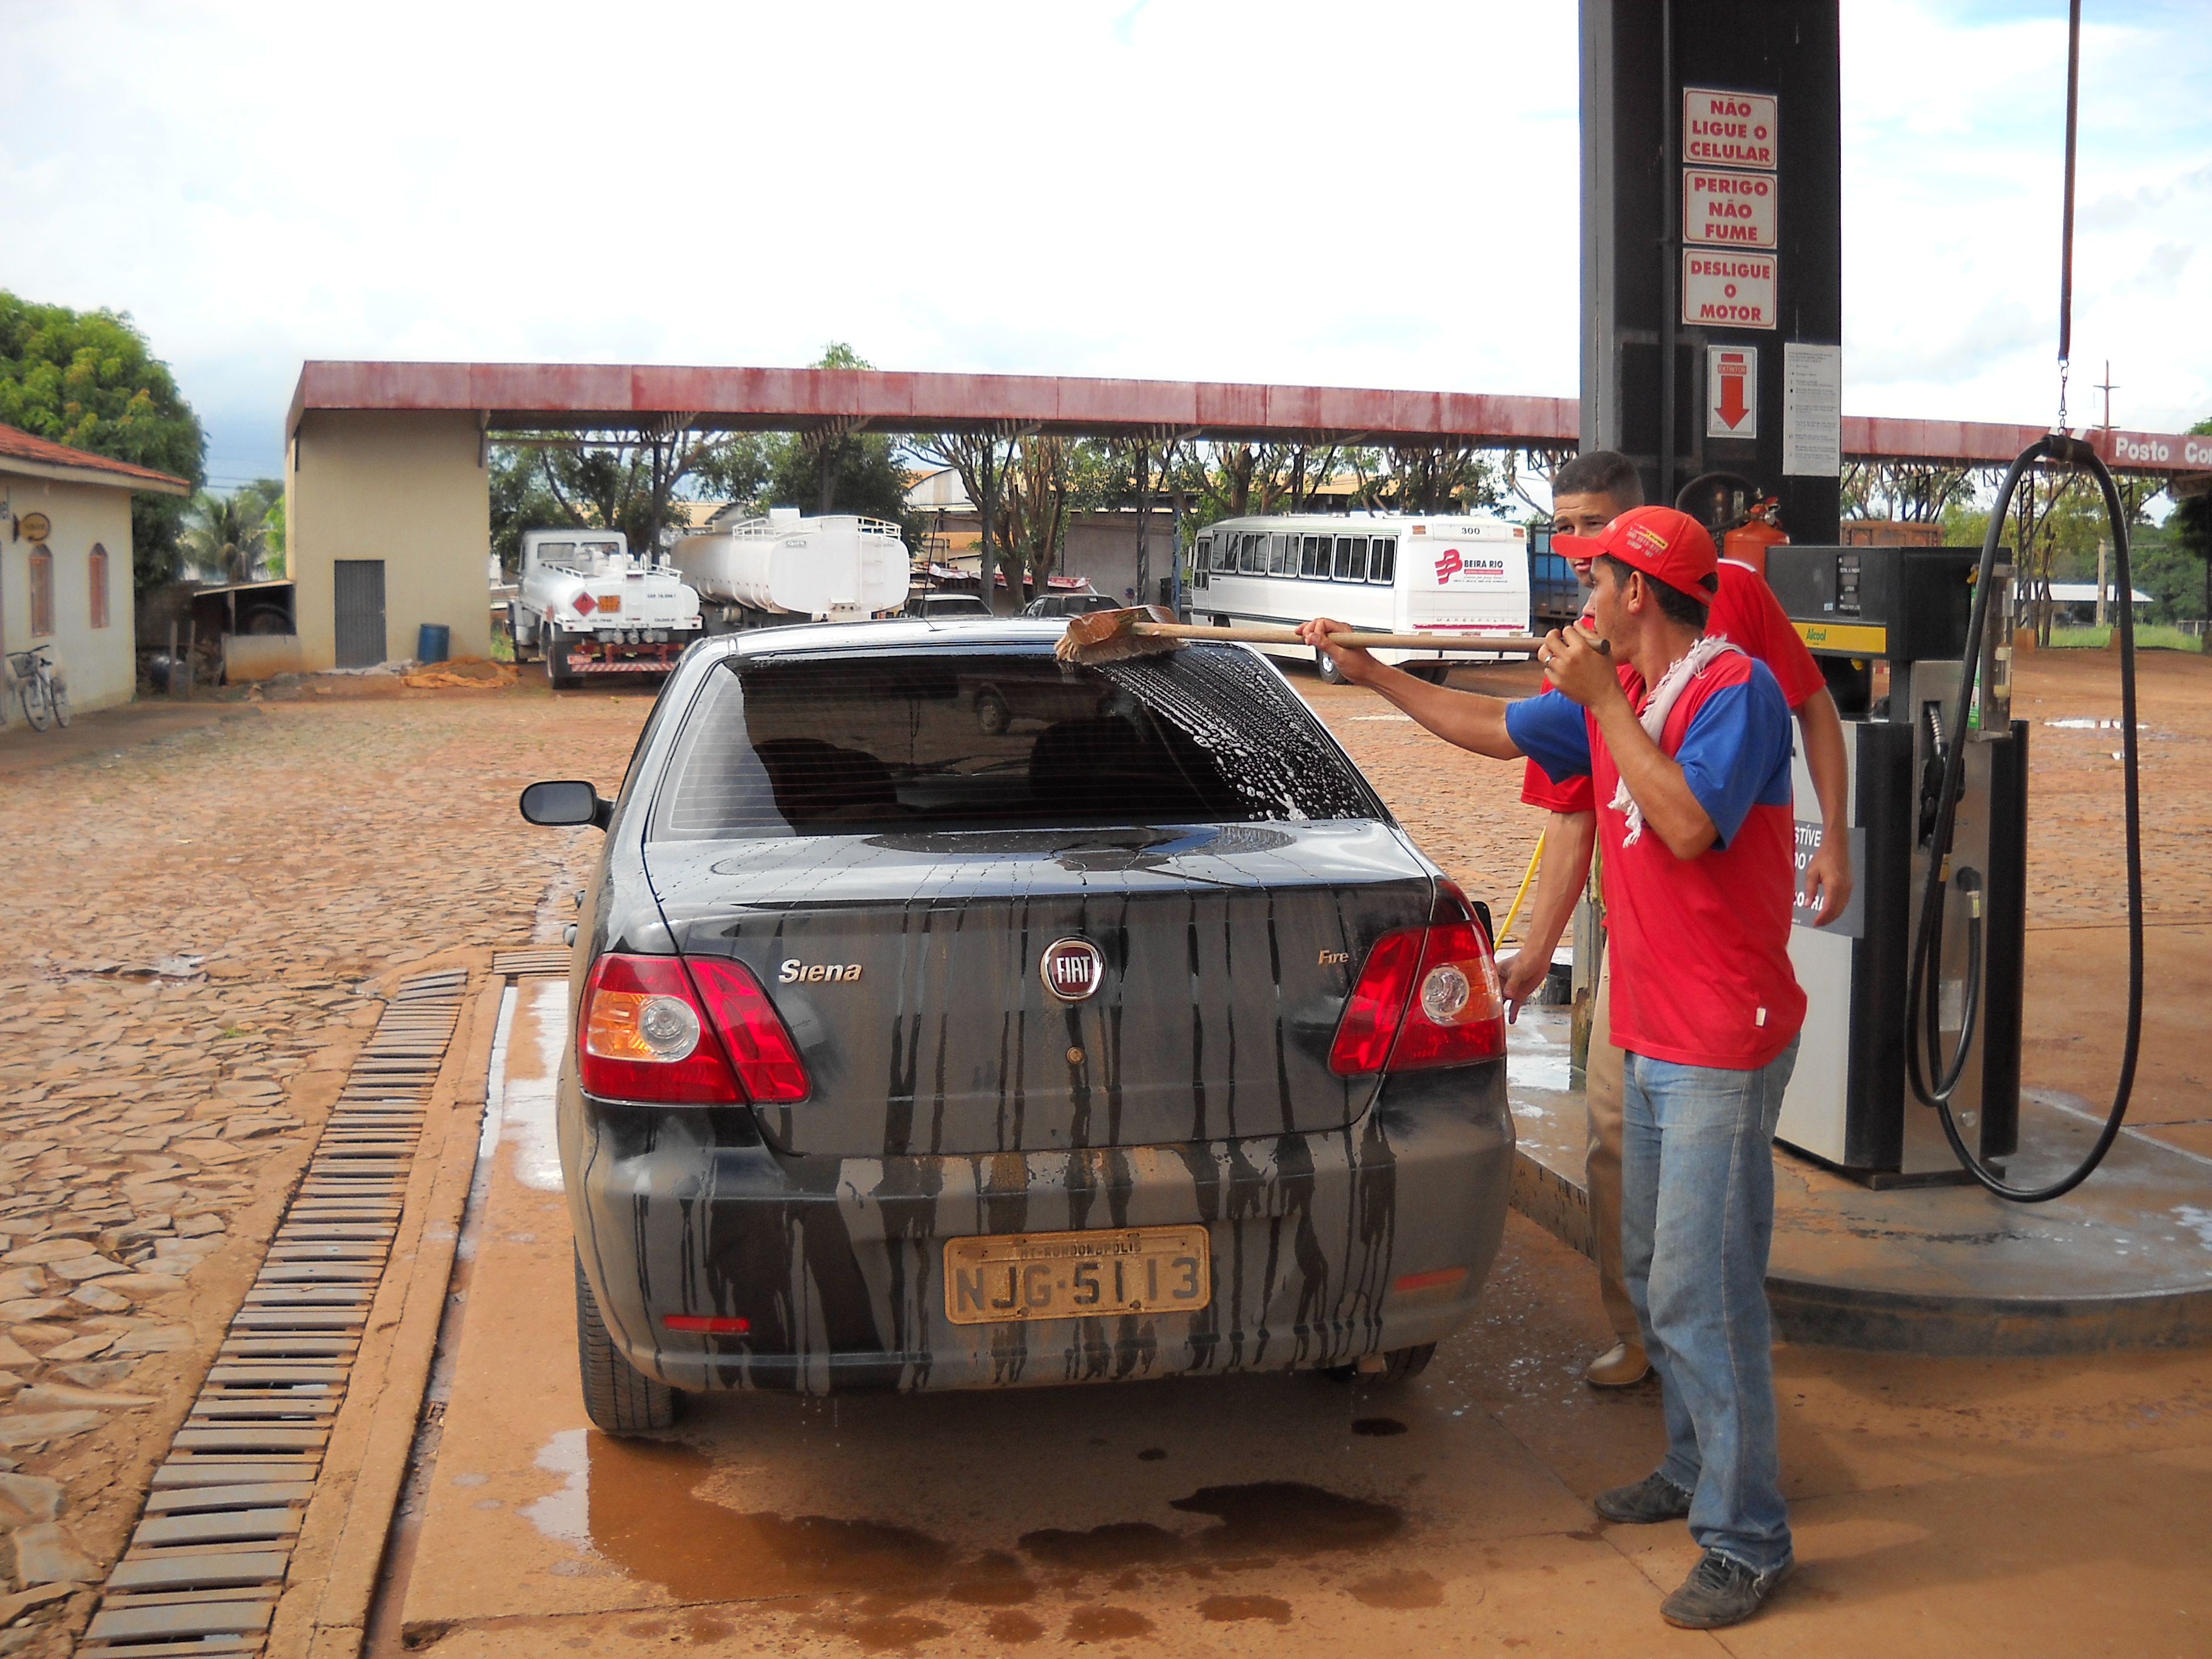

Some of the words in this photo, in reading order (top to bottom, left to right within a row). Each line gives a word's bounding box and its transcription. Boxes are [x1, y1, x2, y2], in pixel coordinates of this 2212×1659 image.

[1711, 98, 1751, 117] NÃO
[1692, 120, 1747, 138] LIGUE
[1754, 126, 1767, 140] O
[1691, 141, 1769, 161] CELULAR
[1694, 177, 1768, 196] PERIGO
[1709, 199, 1752, 219] NÃO
[1705, 224, 1757, 241] FUME
[1691, 260, 1770, 279] DESLIGUE
[1724, 284, 1737, 298] O
[1700, 304, 1761, 321] MOTOR
[2116, 437, 2169, 462] Posto
[1464, 560, 1487, 568] BEIRA
[1794, 825, 1822, 847] STÍVE
[1318, 950, 1349, 965] Fire
[779, 959, 862, 984] Siena
[1056, 956, 1090, 984] FIAT
